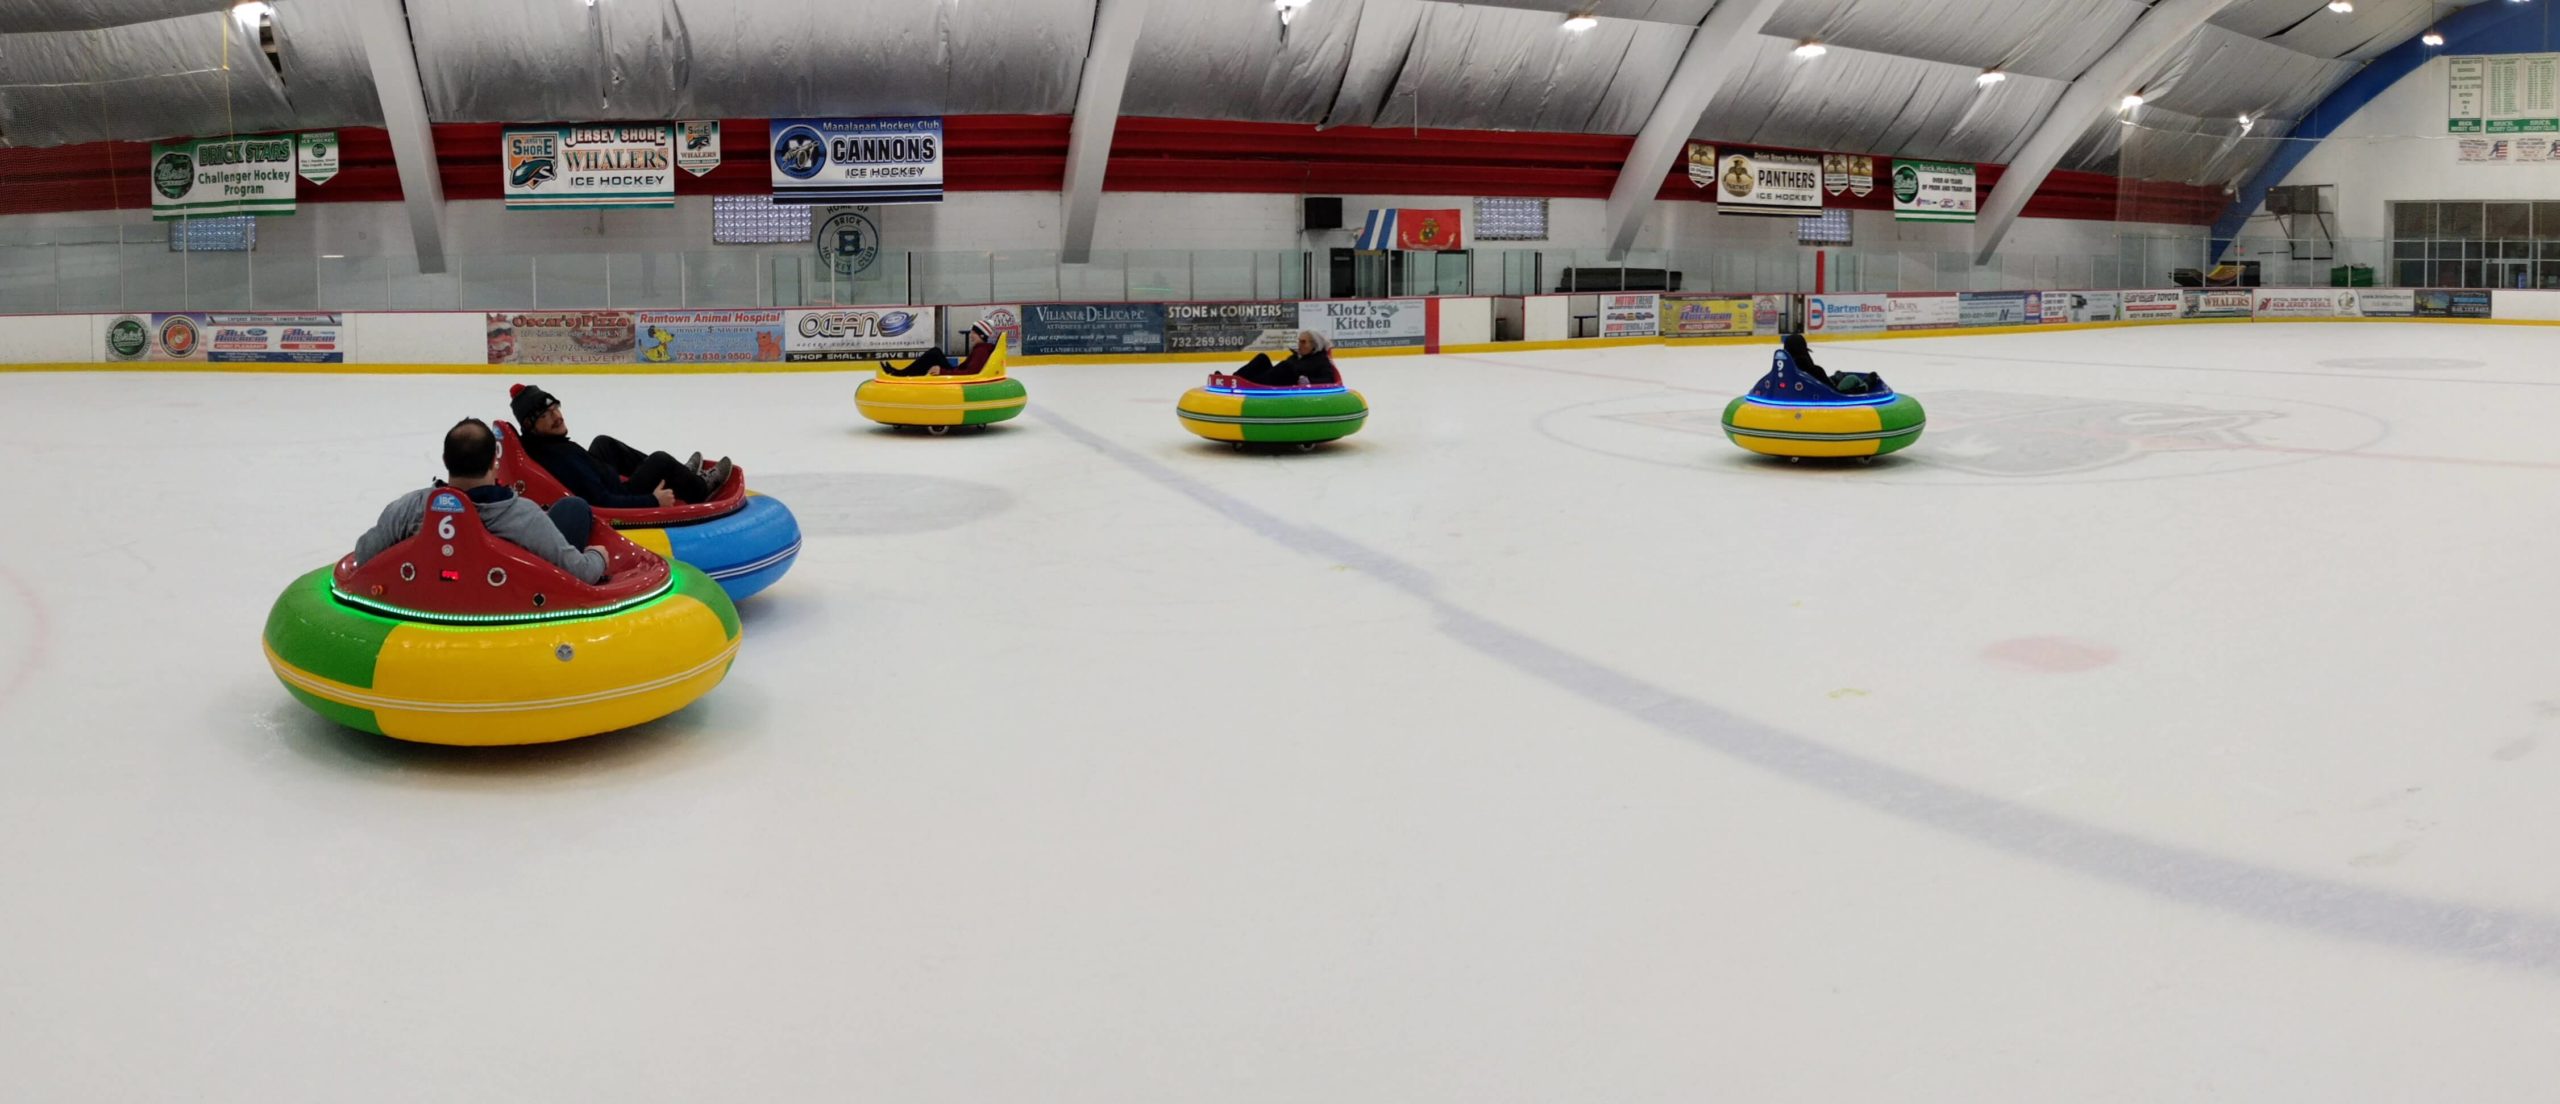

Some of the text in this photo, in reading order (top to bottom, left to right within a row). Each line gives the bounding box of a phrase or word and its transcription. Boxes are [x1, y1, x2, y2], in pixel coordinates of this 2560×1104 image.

[823, 120, 940, 134] Manalapan Hockey Club
[565, 126, 666, 147] JERSEY SHORE
[198, 139, 291, 166] BRICK STARS
[512, 138, 553, 156] SHORE
[831, 135, 937, 164] CANNONS
[562, 148, 669, 172] WHALERS
[198, 169, 291, 185] Challenger Hockey
[846, 167, 925, 178] ICE HOCKEY
[1758, 168, 1815, 189] PANTHERS
[570, 175, 665, 186] ICE HOCKEY
[224, 184, 264, 197] Program
[1756, 192, 1815, 201] ICE HOCKEY
[834, 216, 862, 227] BRICK
[822, 246, 875, 271] HOKEY CLUB
[2203, 296, 2251, 307] WHALERS
[1168, 306, 1209, 319] STONE
[1210, 308, 1217, 317] N
[1219, 305, 1282, 317] COUNTERS
[1327, 301, 1377, 317] Klotz's
[512, 314, 629, 328] Oscar's Pizza
[640, 312, 781, 325] Ramtown Animal Hospital
[799, 312, 880, 338] OCEAN
[1335, 317, 1391, 330] Kitchen
[1171, 336, 1244, 348] 732.269.9600
[677, 352, 695, 360] 732
[1776, 359, 1784, 371] 9
[438, 514, 456, 540] 6
